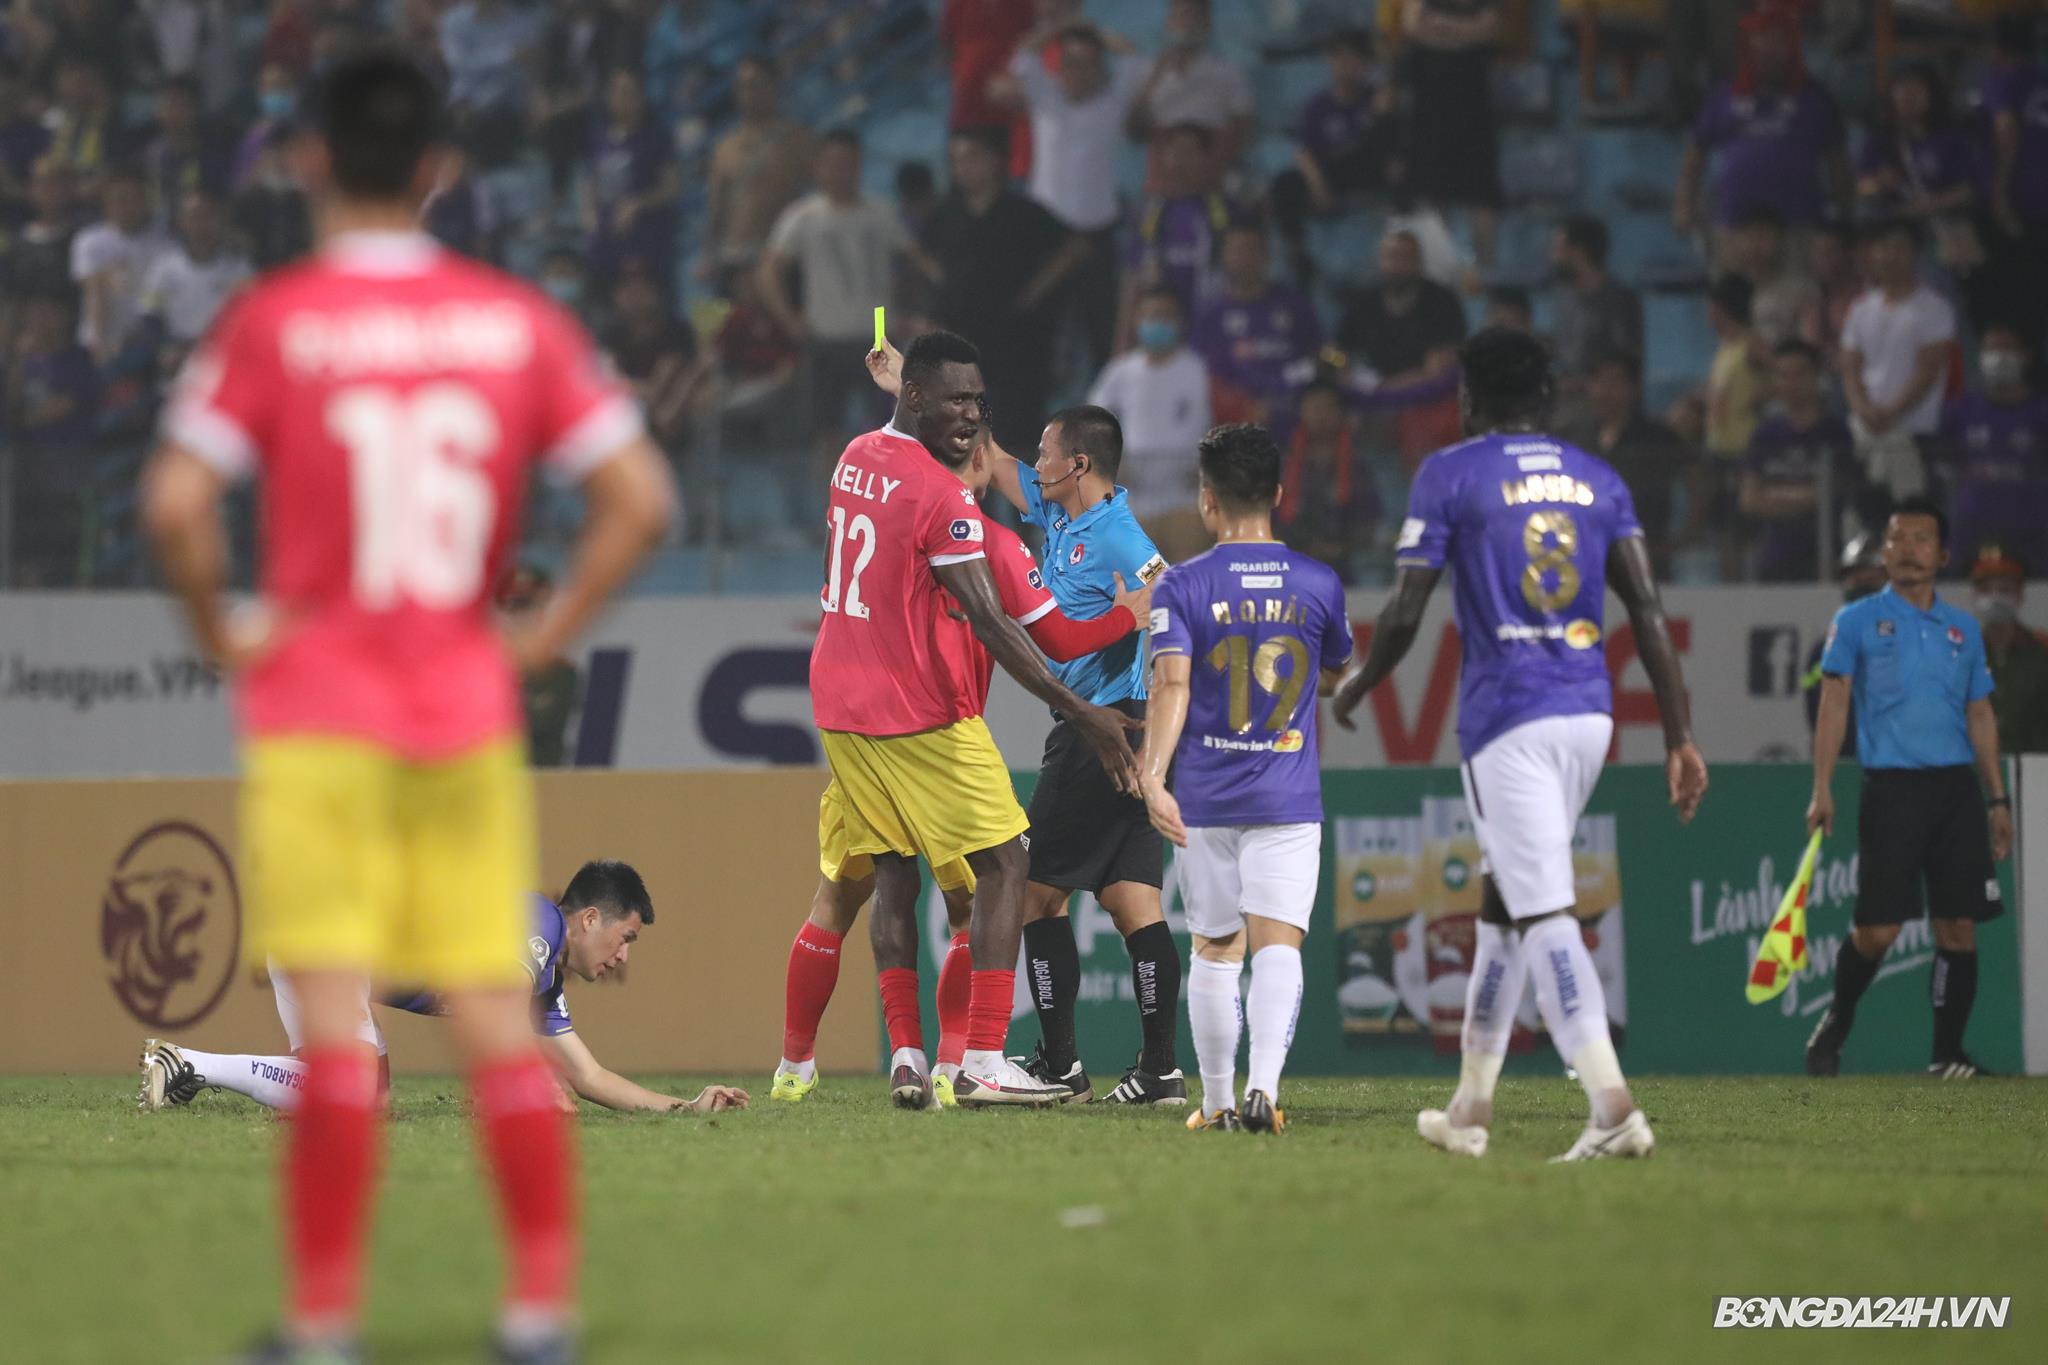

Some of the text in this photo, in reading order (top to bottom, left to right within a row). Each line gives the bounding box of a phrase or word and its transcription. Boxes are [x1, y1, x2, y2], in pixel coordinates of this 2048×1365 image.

[325, 386, 498, 609] 16
[831, 462, 901, 504] KELLY
[827, 506, 876, 622] 12
[1229, 562, 1290, 572] JOGARBOLA
[1521, 511, 1580, 615] 8
[1206, 635, 1308, 734] 19
[1033, 958, 1054, 1010] JOGARBOLA
[1137, 960, 1157, 1016] JOGARBOLA
[251, 1060, 306, 1092] OGARBOLA
